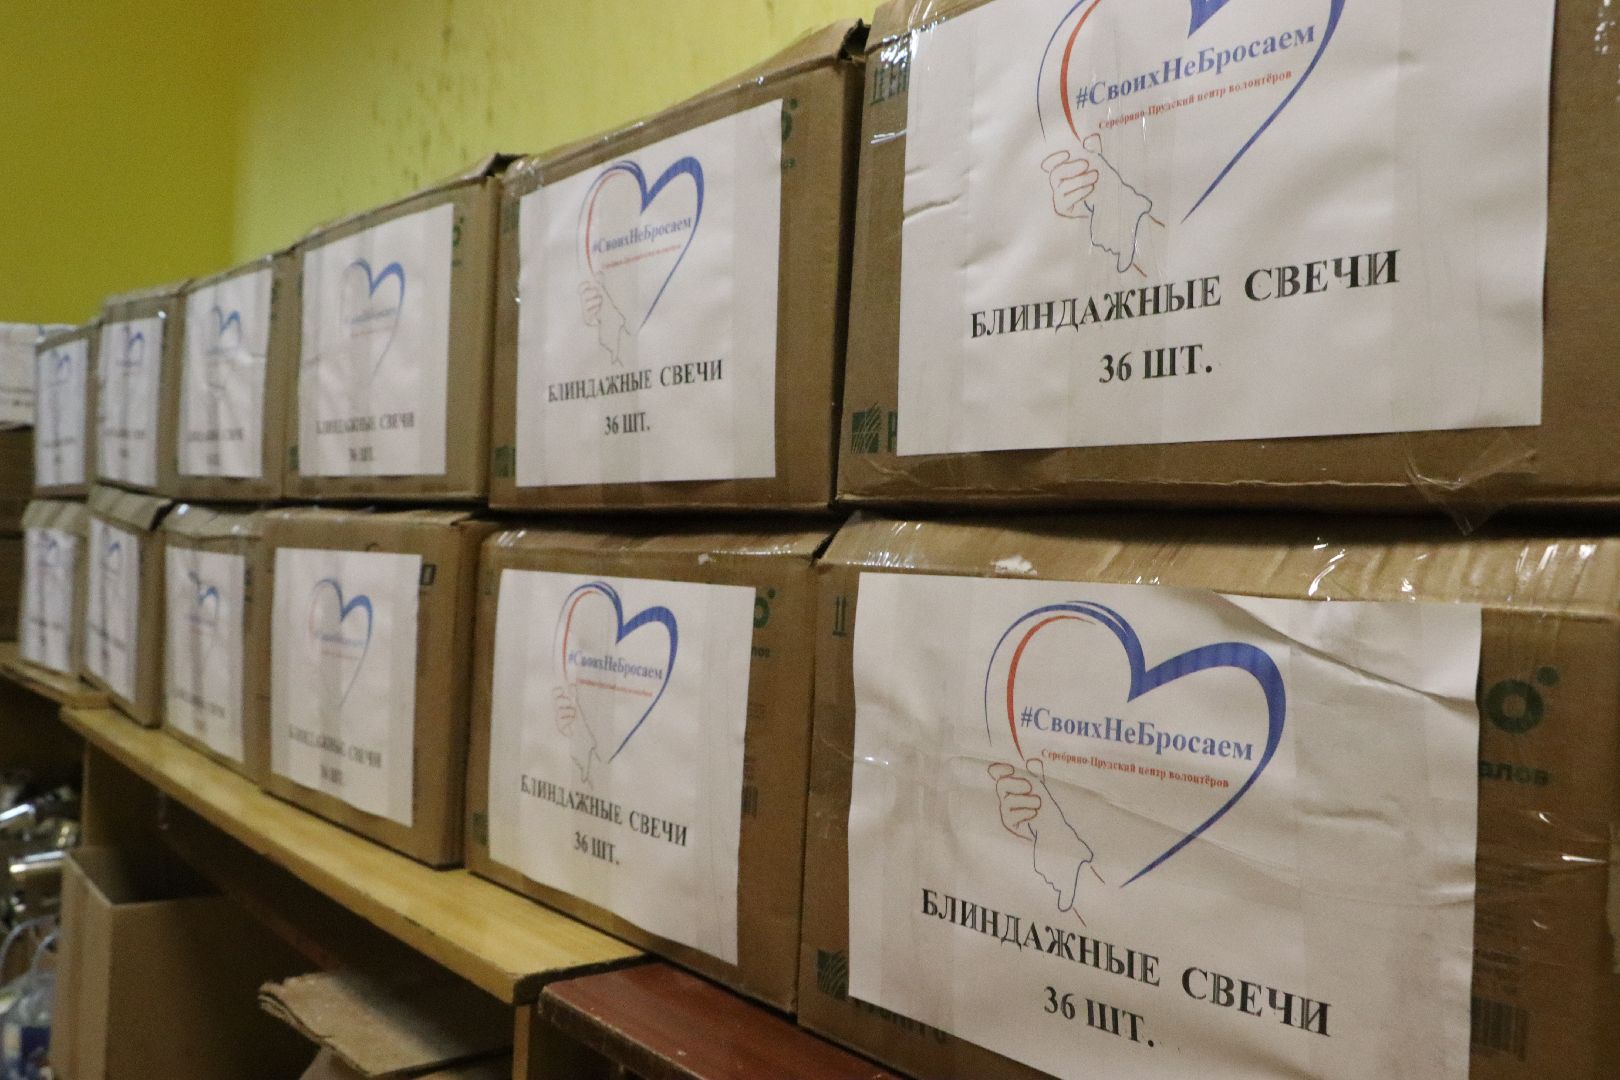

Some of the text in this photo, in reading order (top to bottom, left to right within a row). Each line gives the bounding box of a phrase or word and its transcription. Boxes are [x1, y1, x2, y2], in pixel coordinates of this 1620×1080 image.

[1076, 24, 1315, 110] #СвоихНеБросаем
[1098, 70, 1292, 130] Серебряно-Прудский центр волонтёров
[970, 248, 1401, 339] БЛИНДАЖНЫЕ СВЕЧИ
[548, 358, 723, 402] БЛИНДАЖНЫЕ СВЕЧИ
[1099, 343, 1213, 384] 36 ШТ.
[604, 411, 650, 436] 36 ШТ.
[1021, 705, 1254, 761] #СвоихНеБросаем
[1041, 748, 1230, 789] Серебряно-Прудский центр волонтёров
[521, 773, 688, 847] БЛИНДАЖНЫЕ СВЕЧИ
[574, 831, 620, 866] 36 ШТ.
[921, 888, 1332, 1037] БЛИНДАЖНЫЕ СВЕЧИ
[1044, 985, 1155, 1048] 36 ШТ.
